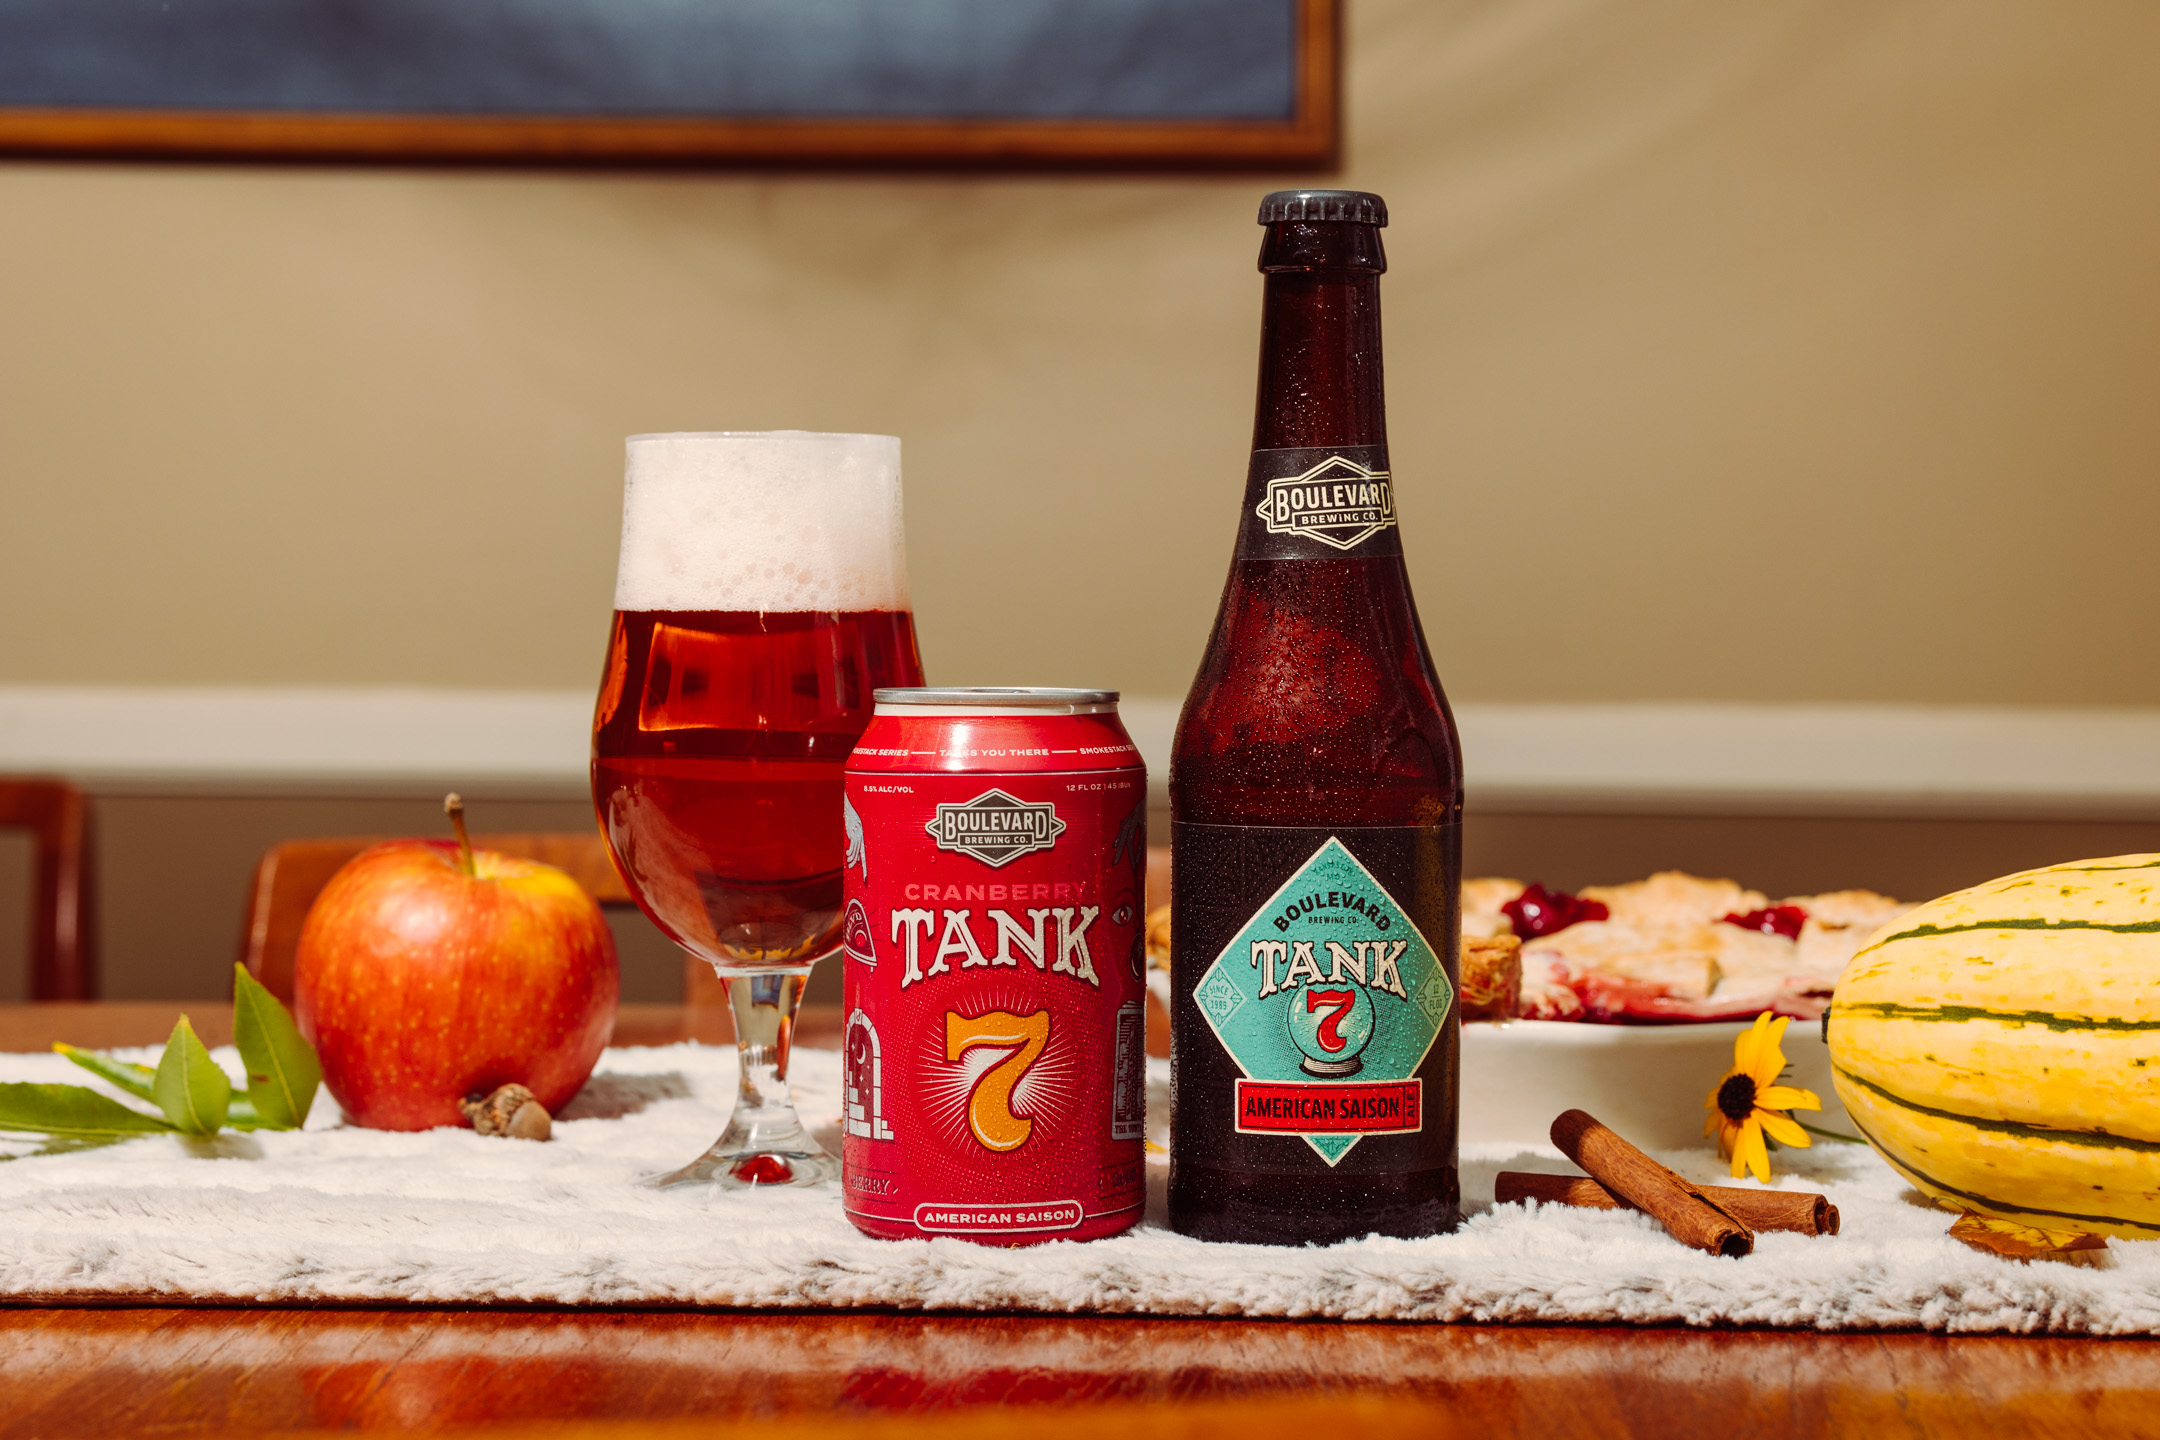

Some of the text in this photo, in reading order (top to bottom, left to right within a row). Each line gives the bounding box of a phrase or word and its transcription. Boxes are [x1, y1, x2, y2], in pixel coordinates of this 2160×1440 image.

[1276, 482, 1391, 522] BOULEVARD
[1301, 511, 1378, 525] BREWING CO.
[939, 749, 978, 757] TAES
[1079, 745, 1127, 755] SMOKESTACK
[945, 811, 1046, 840] BOULEVARD
[964, 835, 1029, 844] BREWING CO.
[904, 882, 1088, 901] CRANBERRY
[1273, 892, 1391, 932] BOULEVARD
[891, 905, 1100, 989] TANK
[1251, 940, 1407, 1002] TANK
[1209, 985, 1228, 996] SINCE
[1211, 1000, 1227, 1010] 1989
[1307, 989, 1356, 1053] 7
[944, 1008, 1051, 1152] 7
[1245, 1097, 1400, 1119] AMERICAN SAISON
[1405, 1093, 1416, 1119] ALE
[924, 1210, 1075, 1224] AMERICAN SAISON
